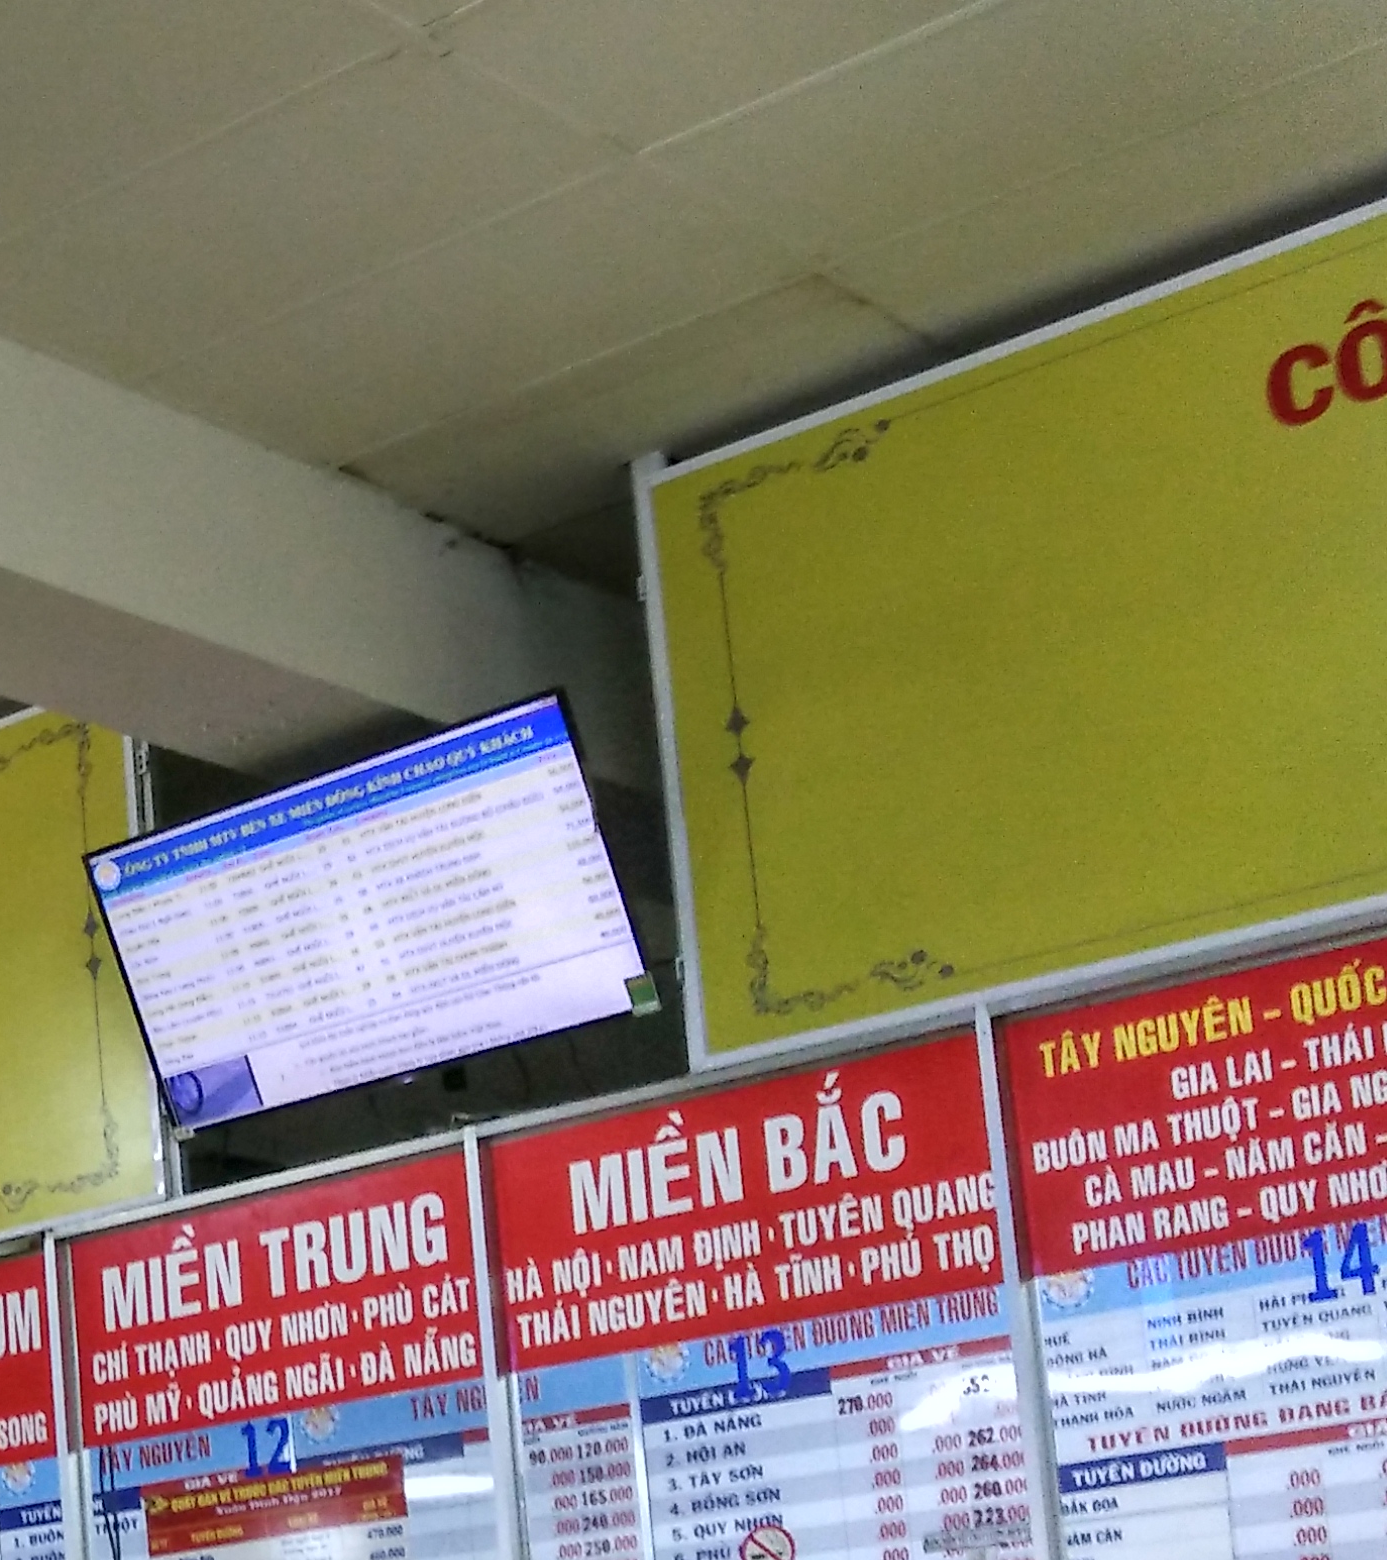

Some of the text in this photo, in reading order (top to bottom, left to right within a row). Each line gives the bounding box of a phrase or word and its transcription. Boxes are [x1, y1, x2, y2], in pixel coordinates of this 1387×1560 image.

[1039, 1030, 1101, 1078] TÂY
[1113, 993, 1254, 1062] NGUYÊN
[1171, 1022, 1375, 1100] GIA LAI THÁI
[569, 1071, 907, 1236] MIỀN BẮC
[1032, 1127, 1107, 1174] BUÔN
[1114, 1118, 1159, 1158] MA
[1167, 1096, 1260, 1147] THUỘT
[1291, 1081, 1342, 1121] GIA
[506, 1170, 998, 1304] HÀ NỘI NAM ĐỊNH TUYÊN QUANG
[1071, 1211, 1146, 1256] PHAN
[1153, 1195, 1229, 1241] RANG
[1258, 1178, 1320, 1225] QUY
[102, 1191, 449, 1333] MIỀN TRUNG
[518, 1301, 580, 1350] THÁI
[589, 1280, 708, 1336] NGUYÊN
[726, 1261, 765, 1311] HÀ
[934, 1223, 995, 1275] THỌ
[1303, 1222, 1381, 1301] 14
[225, 1317, 272, 1362] QUY
[360, 1341, 396, 1387] ĐÀ
[727, 1329, 792, 1404] 13
